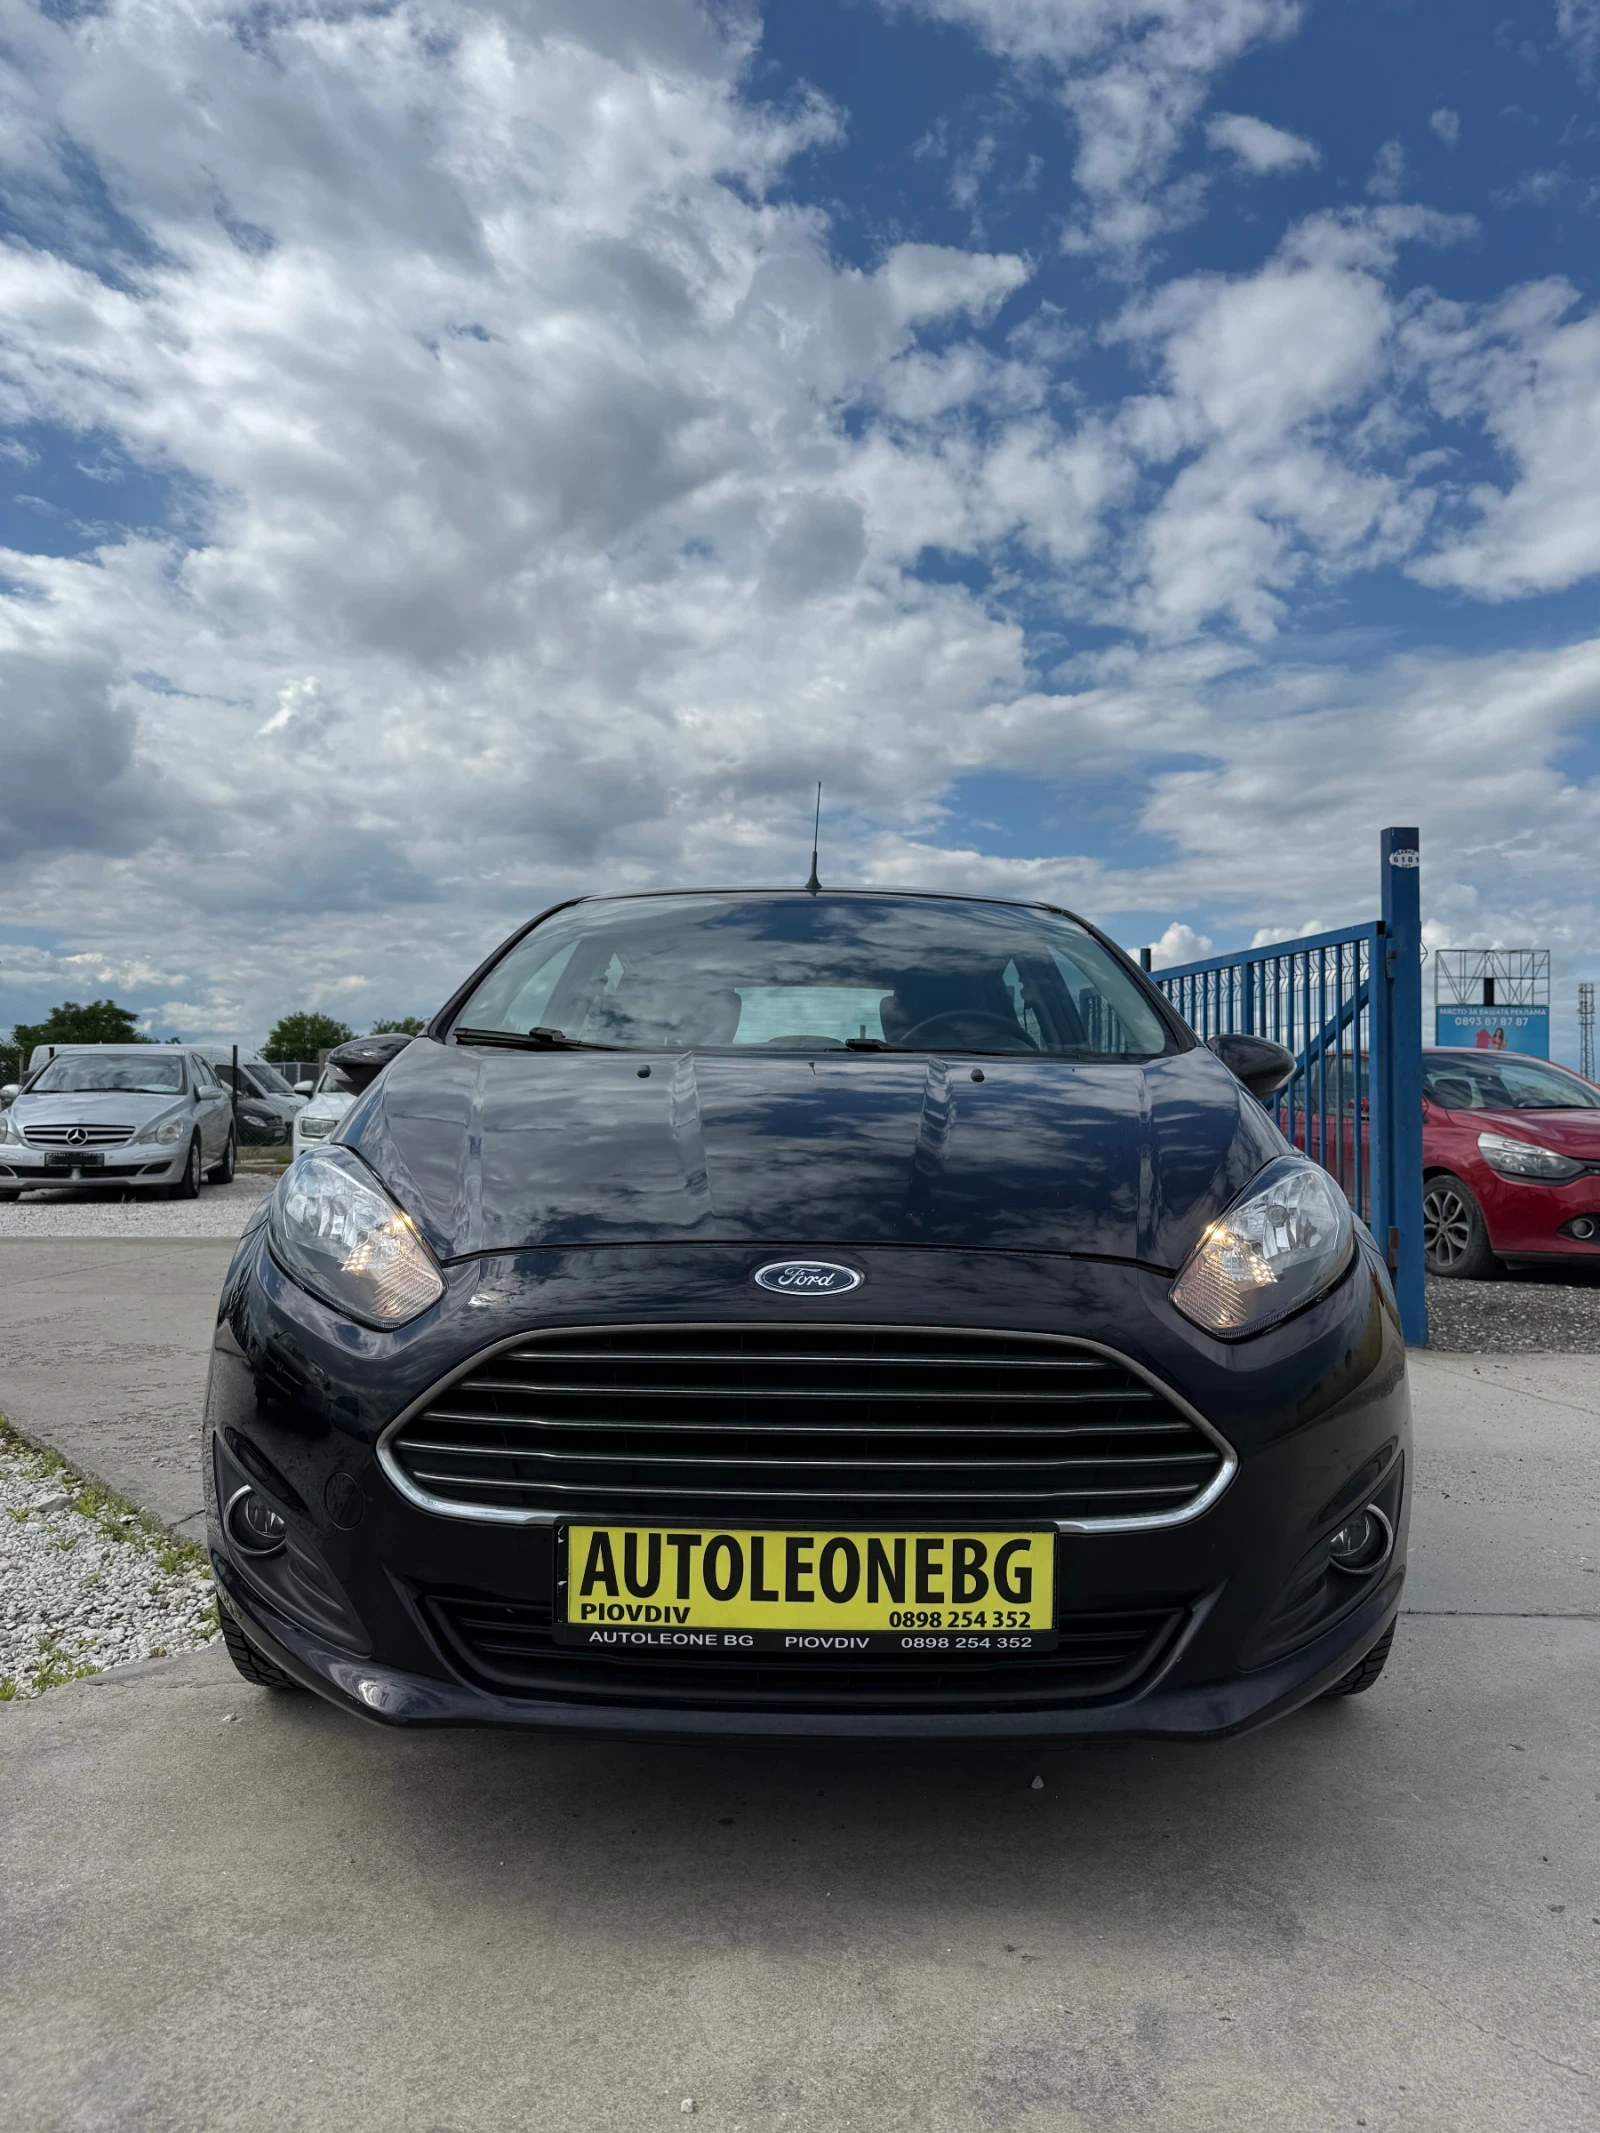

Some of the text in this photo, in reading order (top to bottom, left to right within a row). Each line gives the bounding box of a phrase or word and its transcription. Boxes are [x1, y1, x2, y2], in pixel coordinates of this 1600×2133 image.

[1439, 1008, 1547, 1016] МЯСТО ЗА ВАШАТА РЕКЛАМА
[1454, 1017, 1529, 1027] 0893 87 87 87
[778, 1267, 835, 1287] Ford
[579, 1531, 1033, 1605] AUTOLEONEBG
[580, 1603, 691, 1624] PIOVDIV
[889, 1611, 1031, 1629] 0898 254 352
[589, 1631, 1032, 1649] AUTOLEONE BG PIOVDIV 0898 254 352
